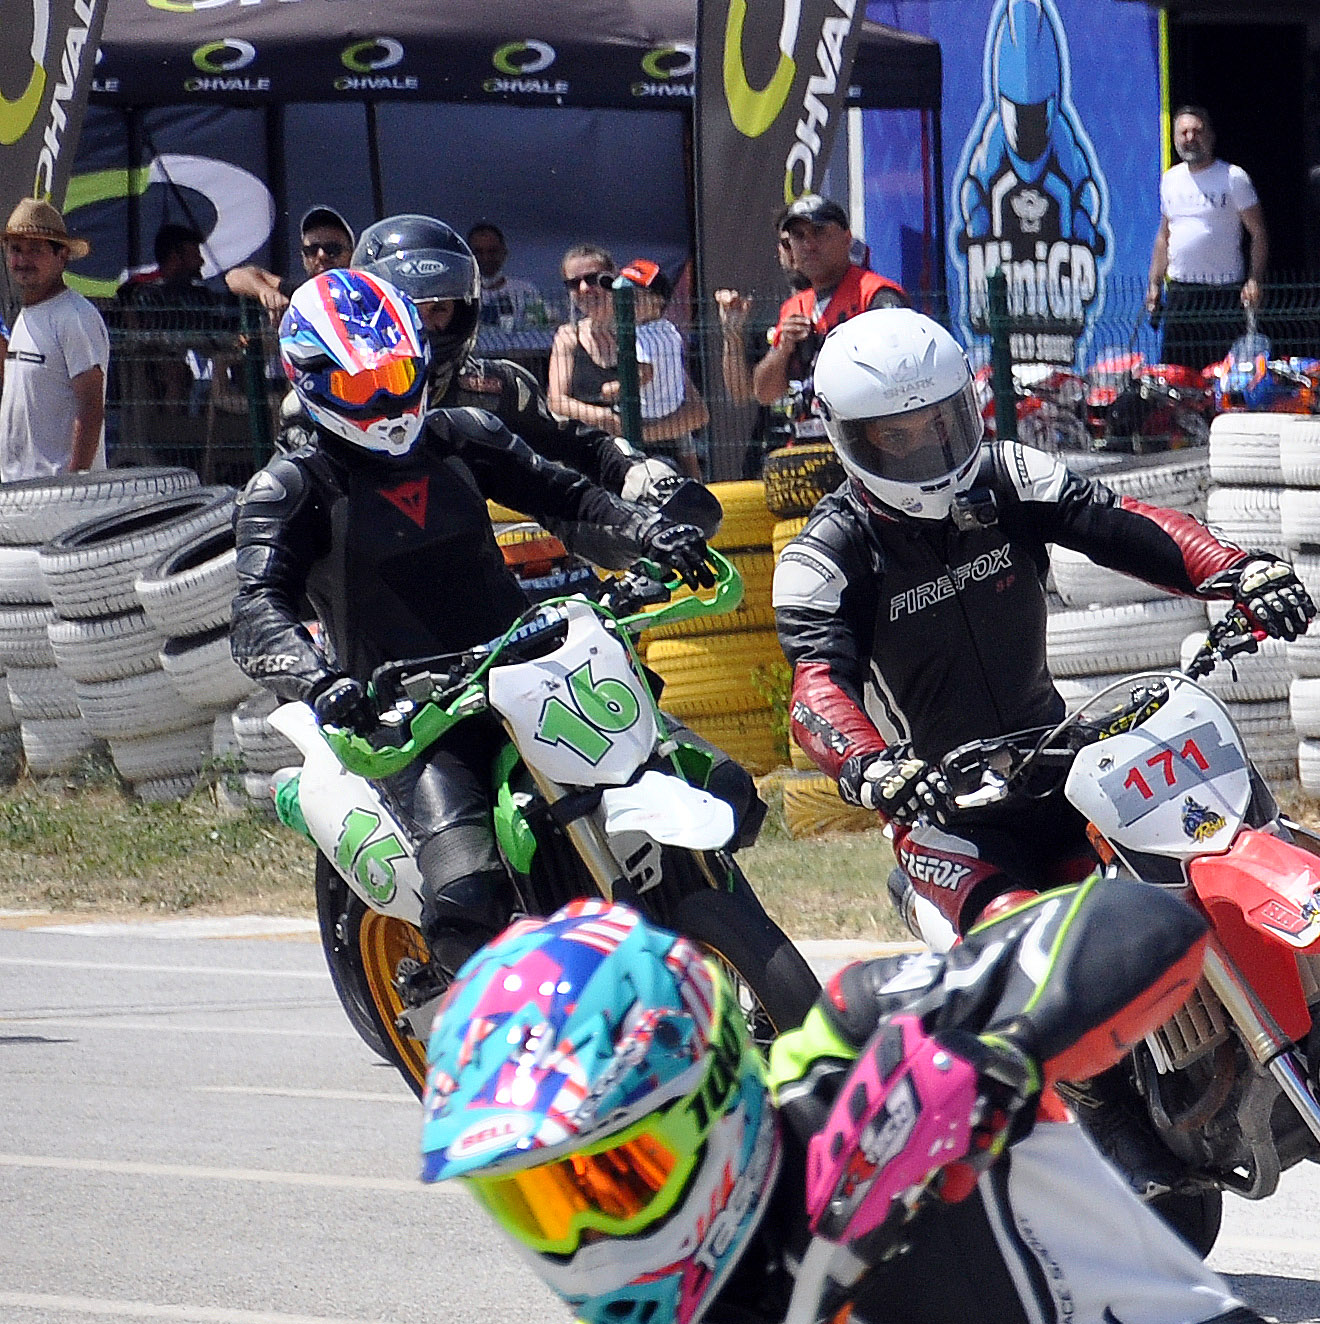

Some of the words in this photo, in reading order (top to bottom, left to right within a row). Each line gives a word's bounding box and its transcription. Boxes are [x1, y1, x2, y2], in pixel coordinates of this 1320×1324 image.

[34, 0, 95, 202] OHVAL
[185, 77, 271, 93] OHVALE
[334, 76, 418, 92] OHVALE
[482, 78, 569, 95] OHVALE
[631, 81, 696, 98] OHVAL
[784, 0, 856, 204] OHVA
[883, 376, 935, 399] SHARK
[889, 542, 1011, 622] FIREFOX
[534, 660, 640, 767] 16
[1123, 738, 1210, 800] 171
[334, 806, 410, 908] 16
[460, 1122, 516, 1151] BELL
